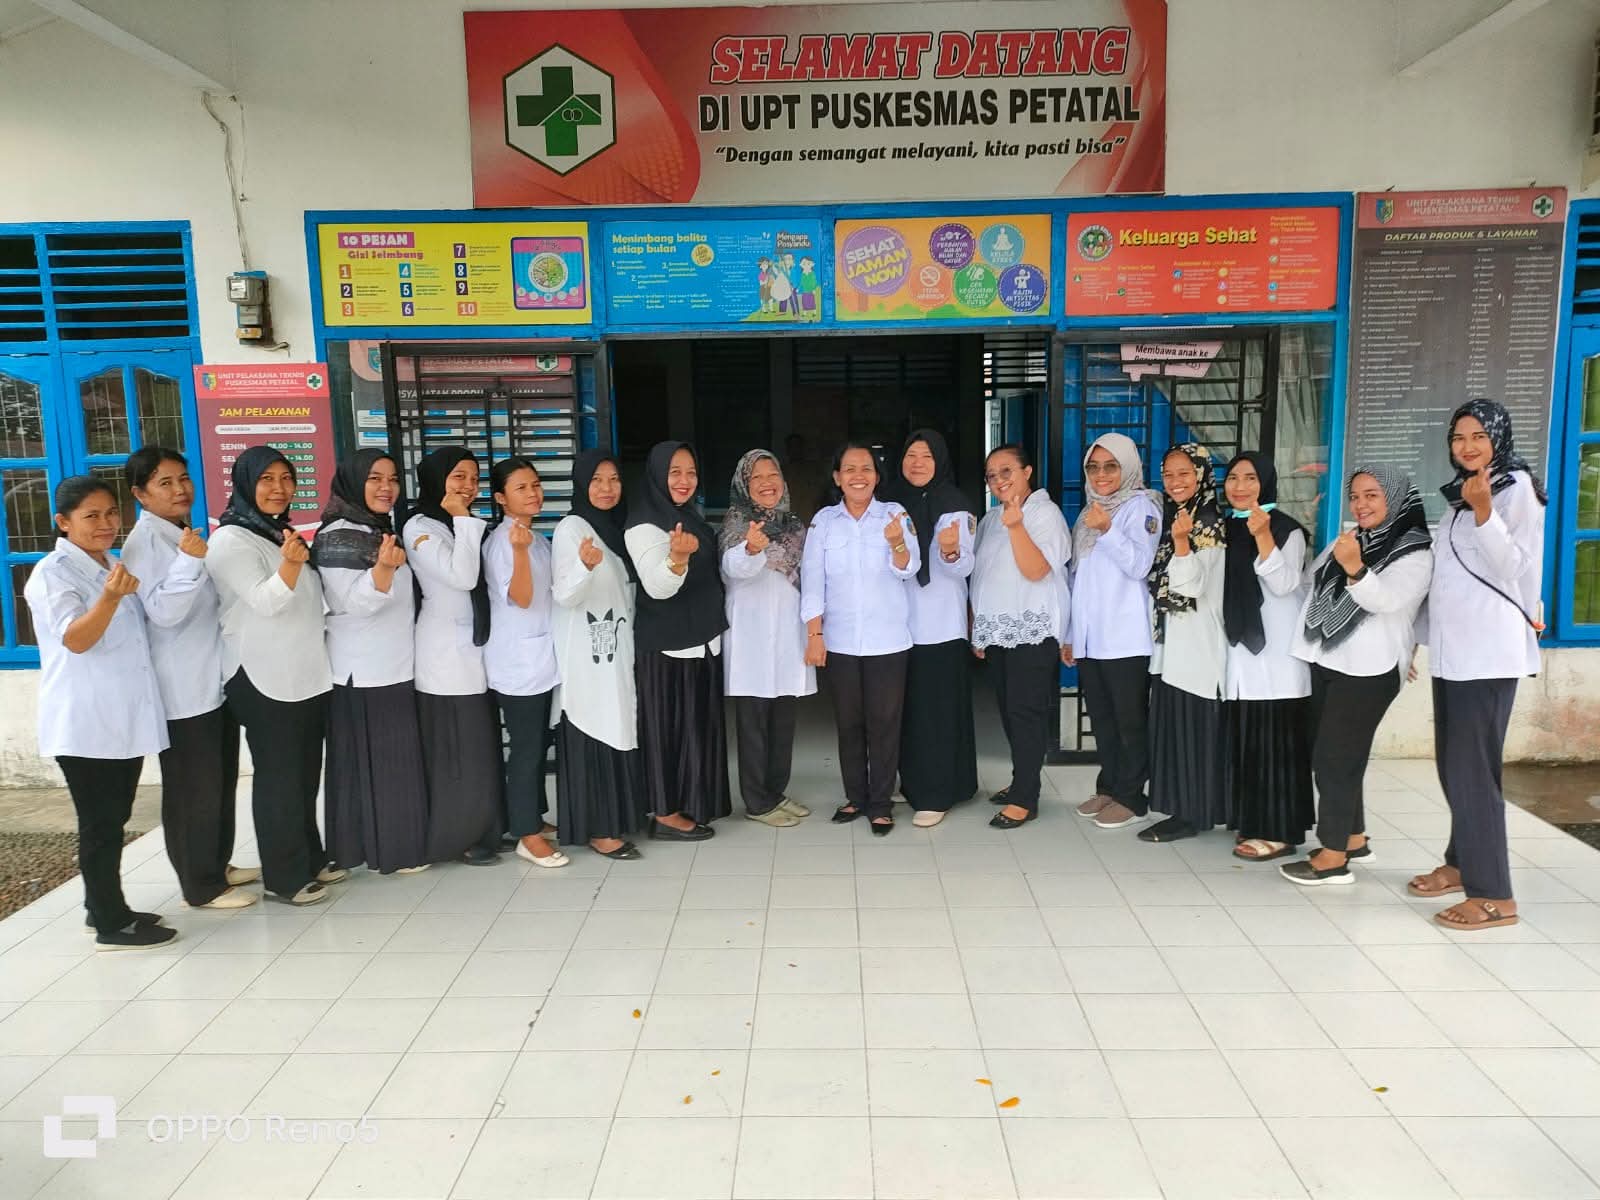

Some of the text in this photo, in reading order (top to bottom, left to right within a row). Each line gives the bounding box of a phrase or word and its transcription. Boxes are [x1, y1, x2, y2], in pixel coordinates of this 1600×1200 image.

[710, 26, 1131, 84] SELAMAT DATANG
[700, 87, 1140, 131] DI UPT PUSKESMAS PETATAL
[799, 146, 885, 162] semangat
[891, 141, 979, 161] melayani,
[985, 141, 1020, 157] kita
[1025, 139, 1070, 159] pasti
[1406, 199, 1428, 208] UNIT
[1413, 206, 1470, 215] PUSKESMAS
[342, 234, 409, 246] 10 PESAN
[612, 234, 675, 244] Menimbang
[677, 233, 708, 243] balita
[1118, 228, 1200, 249] Keluarga
[1204, 226, 1258, 244] Sehat
[1384, 233, 1427, 241] DAFTAR
[1429, 231, 1475, 240] PRODUK
[1487, 229, 1539, 238] LAYANAN
[348, 251, 369, 260] Gizi
[455, 245, 464, 257] 7
[613, 244, 676, 255] setiap bulan
[845, 236, 897, 265] SEHAT
[847, 247, 908, 279] JAMAN
[341, 266, 348, 278] 1
[401, 265, 409, 276] 4
[457, 264, 464, 276] 8
[864, 264, 903, 288] NOW
[343, 285, 351, 297] 2
[403, 284, 410, 296] 5
[458, 282, 465, 294] 9
[344, 303, 353, 315] 3
[404, 303, 412, 315] 6
[460, 304, 475, 315] 10
[1135, 345, 1209, 358] Membawa anak ke
[218, 406, 311, 418] JAM PELAYANAN
[220, 443, 248, 451] SENIN
